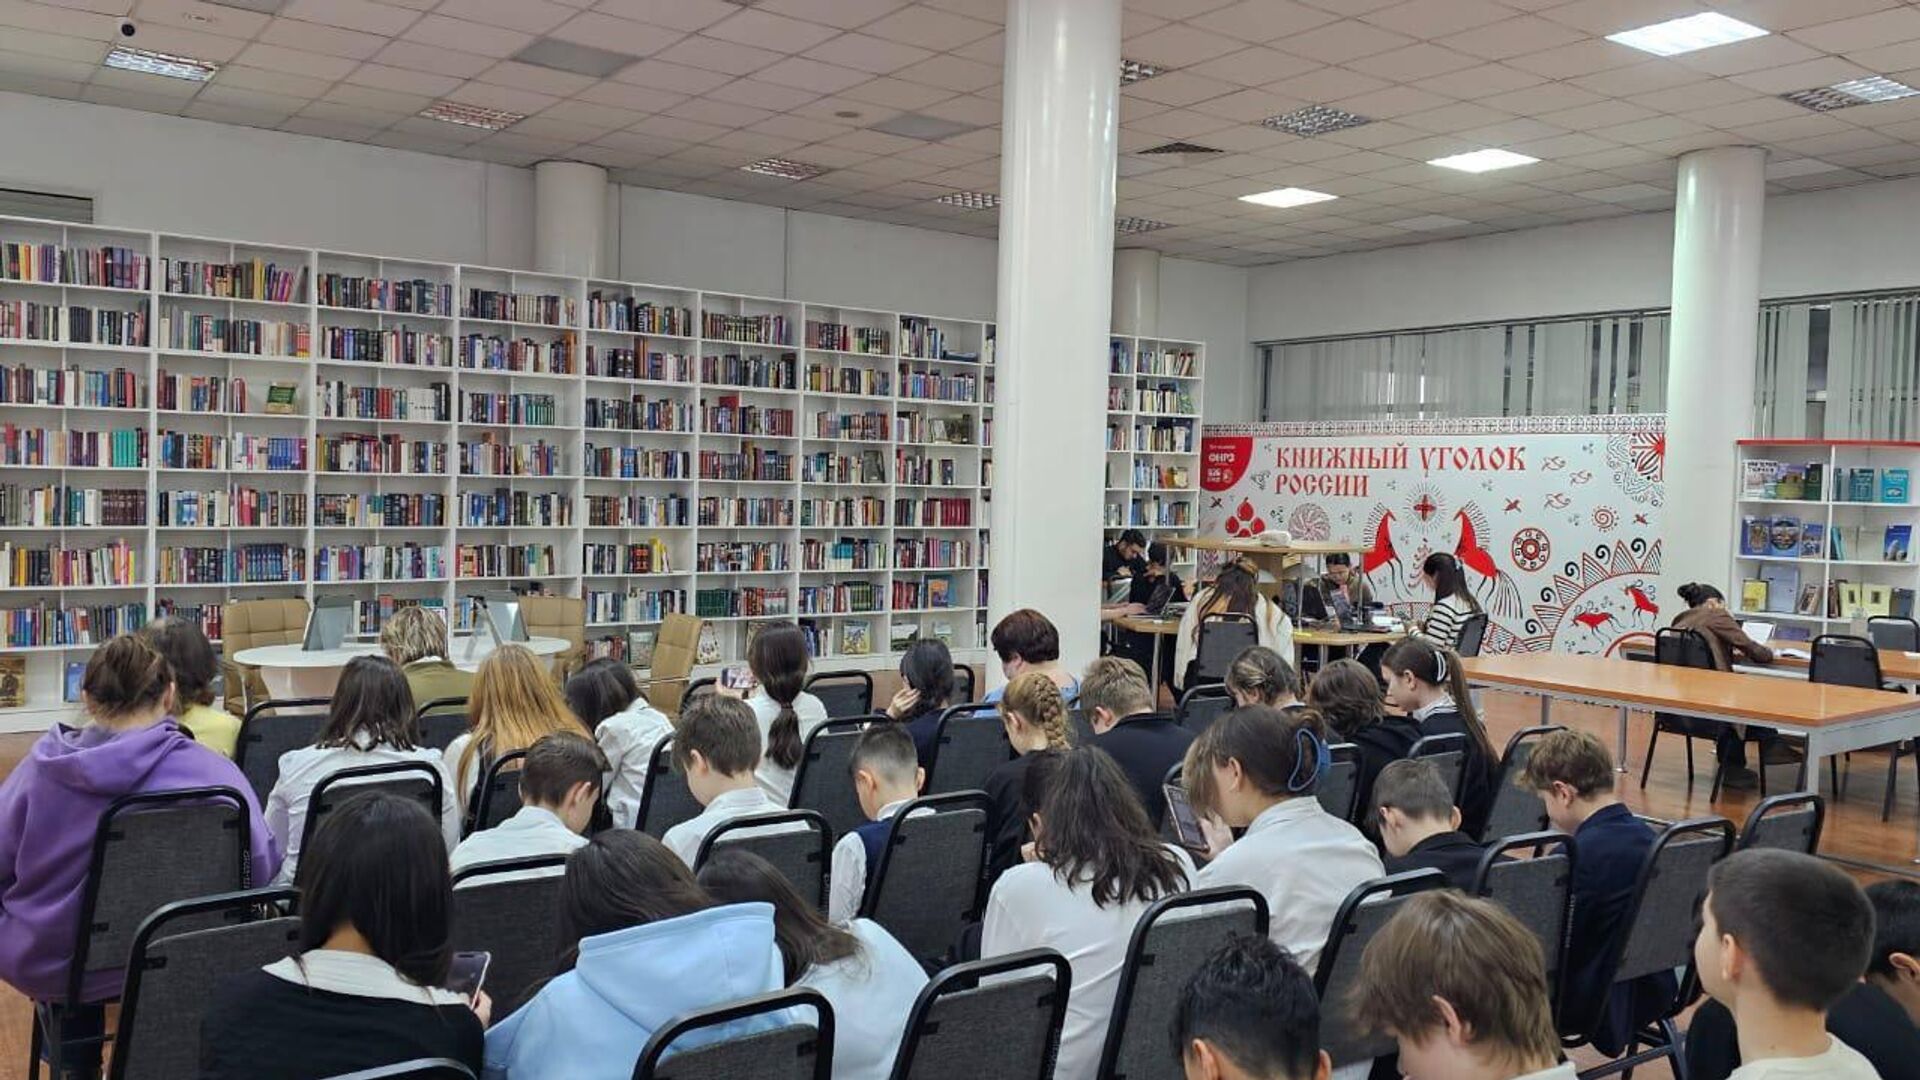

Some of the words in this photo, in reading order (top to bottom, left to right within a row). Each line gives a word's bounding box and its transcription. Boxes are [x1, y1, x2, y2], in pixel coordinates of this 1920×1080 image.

[1276, 442, 1409, 469] КНИЖНЫЙ
[1420, 446, 1527, 478] УГОЛОК
[1275, 474, 1370, 497] РОССИИ
